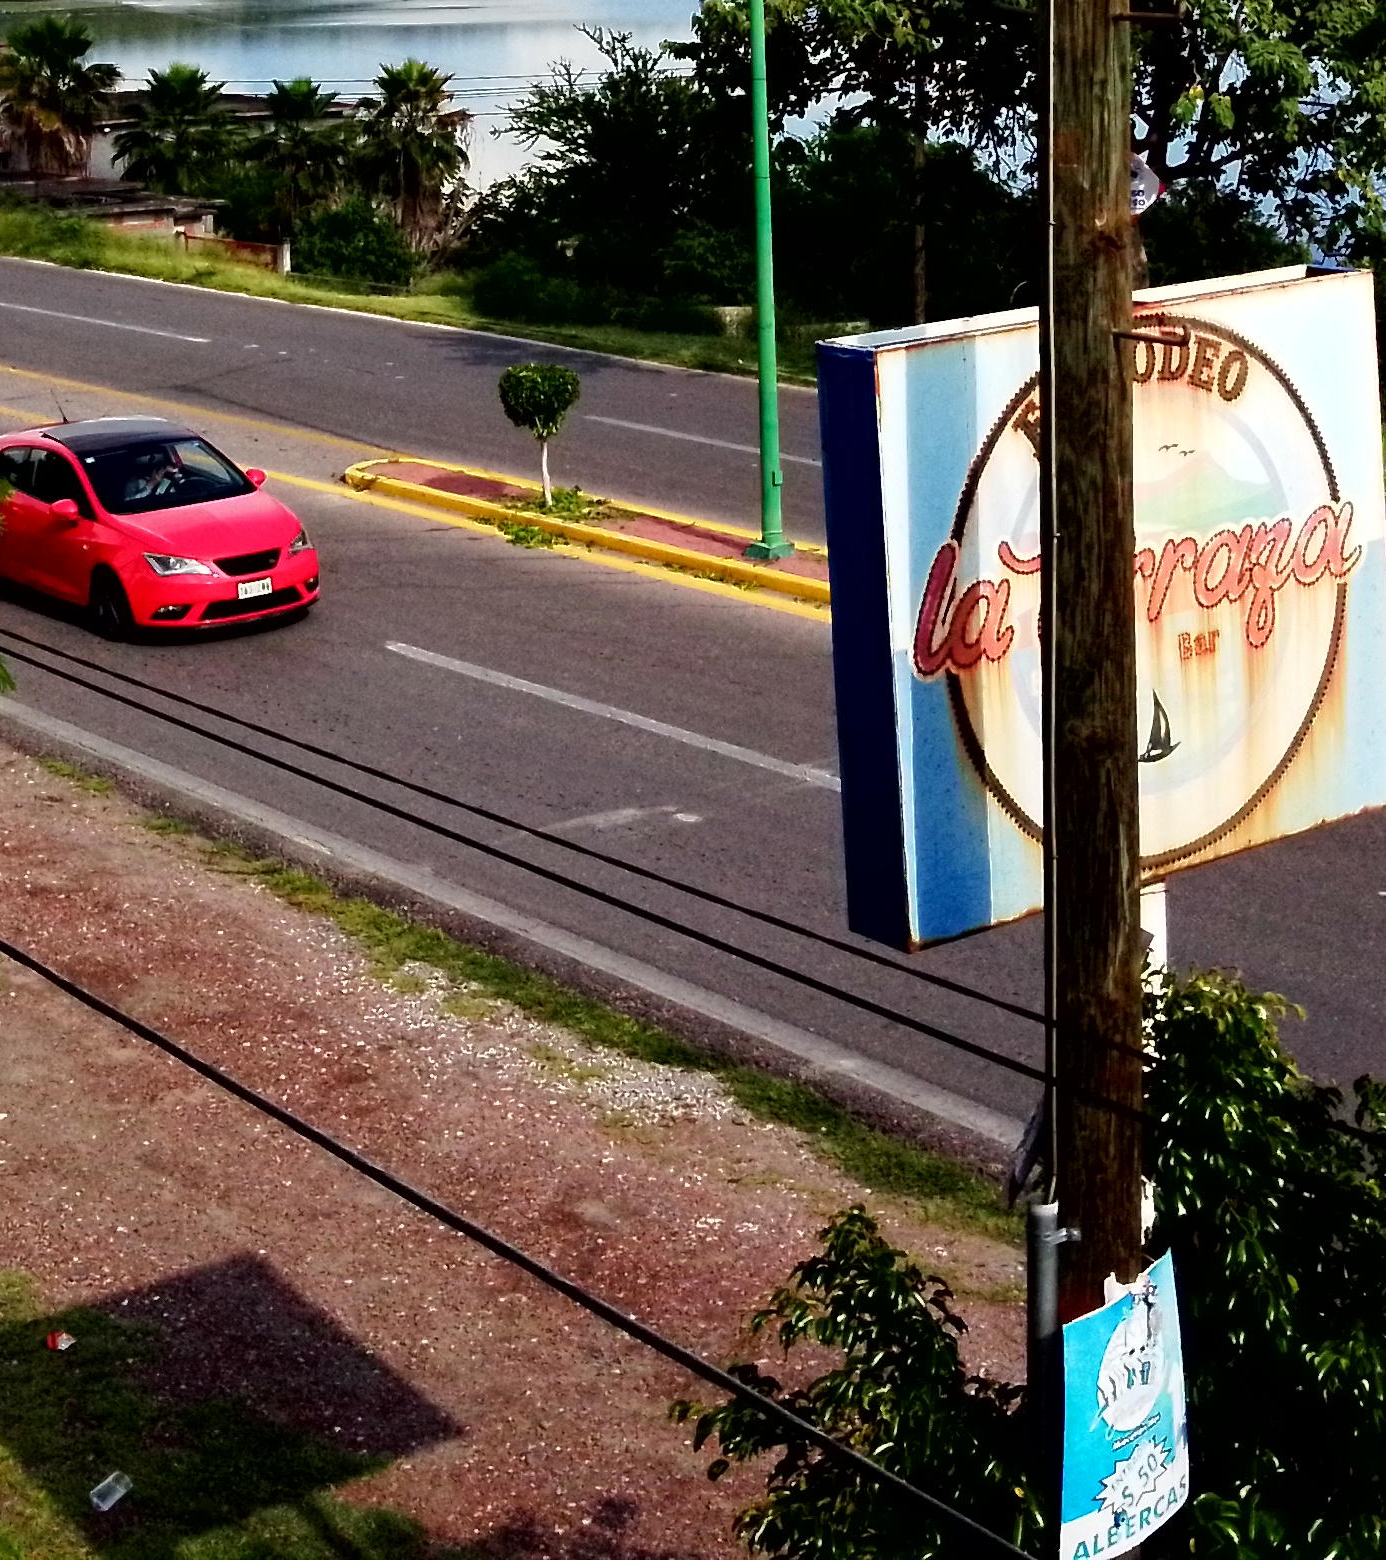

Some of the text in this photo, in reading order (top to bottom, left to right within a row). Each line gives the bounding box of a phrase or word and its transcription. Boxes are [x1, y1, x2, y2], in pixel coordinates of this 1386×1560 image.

[1132, 333, 1249, 402] ODEO
[913, 501, 1362, 676] la raza
[1138, 1453, 1158, 1488] 50
